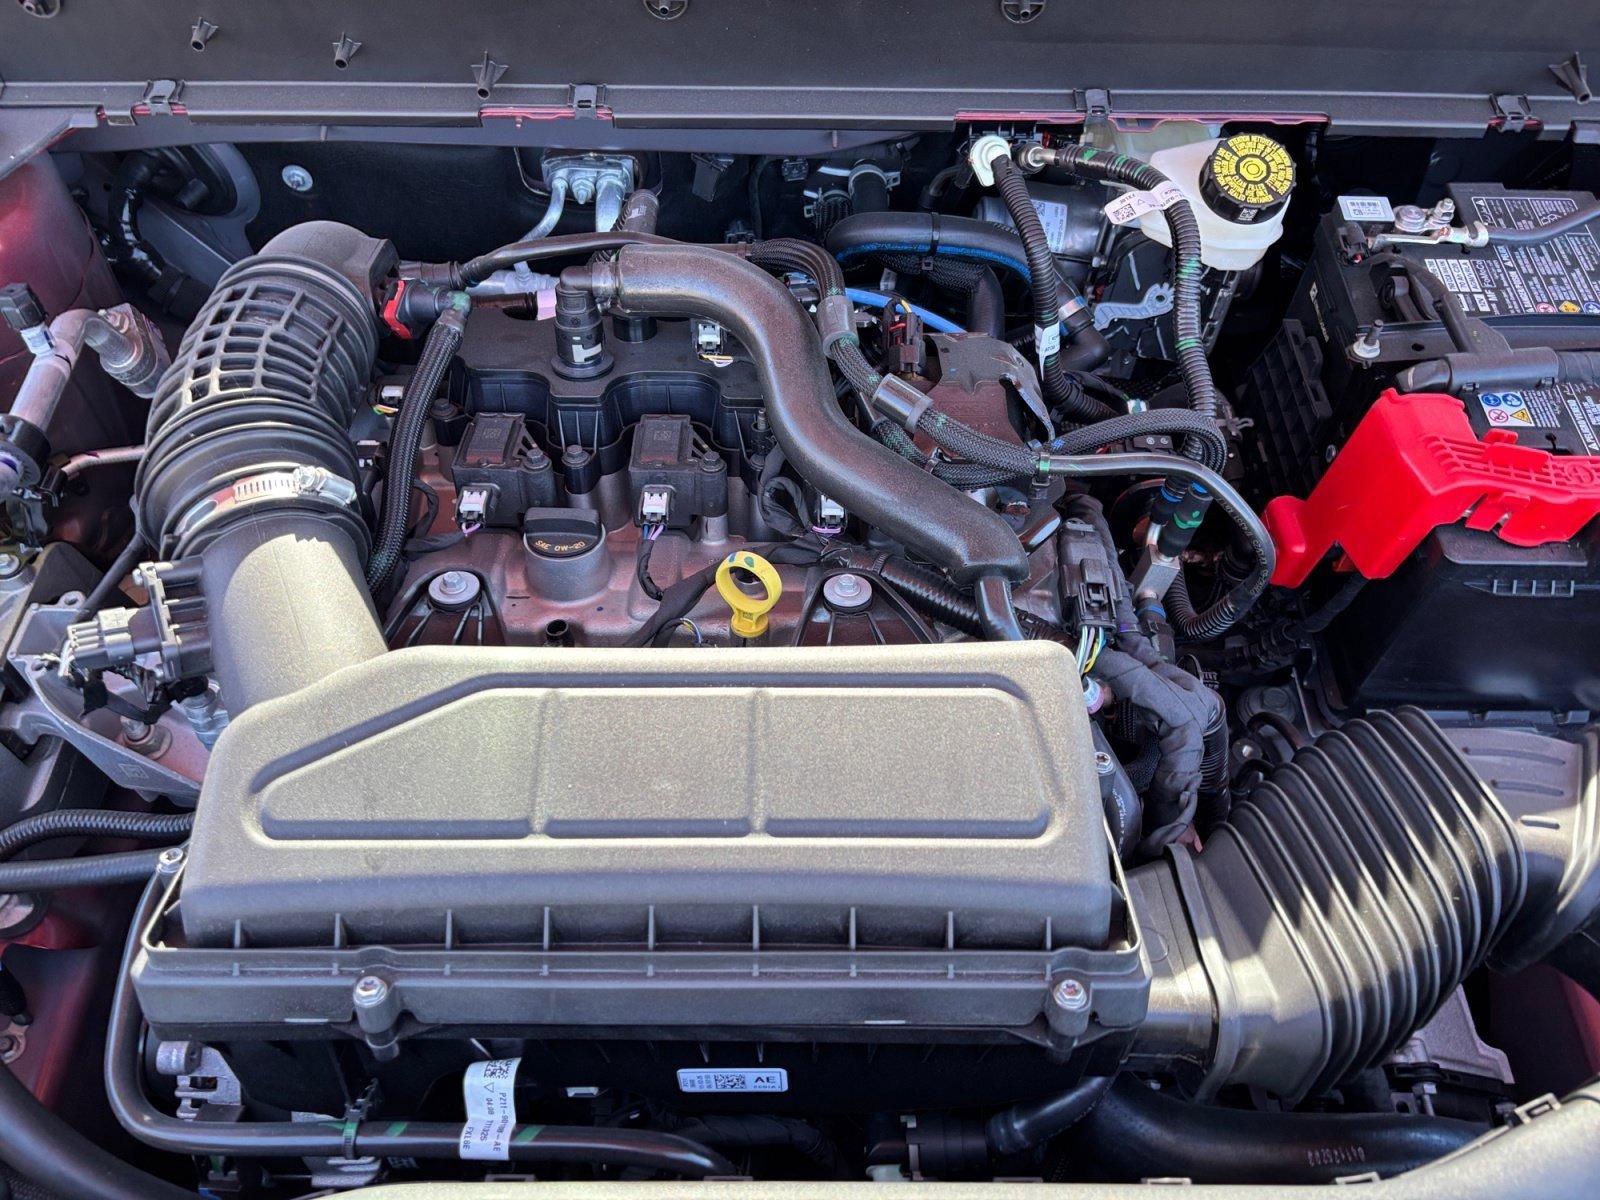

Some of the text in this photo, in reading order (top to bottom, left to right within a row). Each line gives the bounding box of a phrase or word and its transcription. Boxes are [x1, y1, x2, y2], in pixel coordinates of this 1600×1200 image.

[1232, 175, 1248, 188] CLEAN
[1215, 174, 1227, 187] FROM
[1228, 188, 1246, 201] SEALED
[1246, 195, 1274, 204] CONTAINER
[1456, 273, 1464, 282] Ah
[1476, 260, 1490, 287] FoMoCo
[1485, 289, 1498, 301] MF
[1476, 298, 1485, 308] 12V
[536, 540, 586, 551] SAE 0W-20
